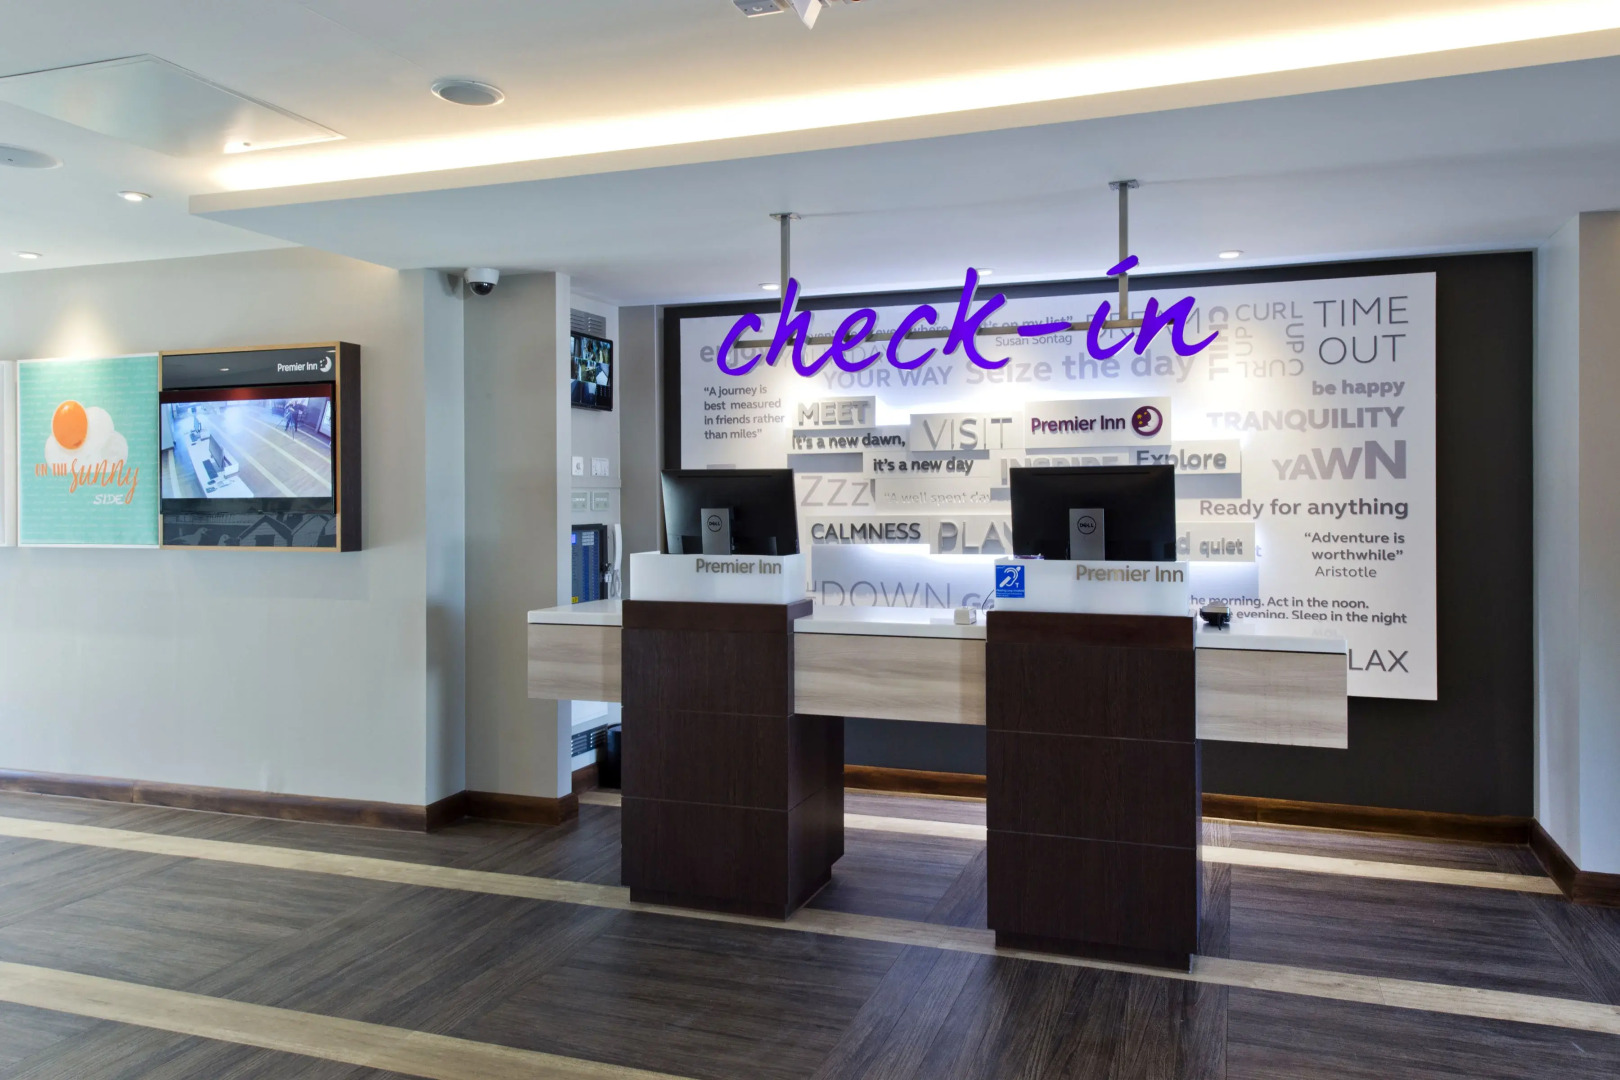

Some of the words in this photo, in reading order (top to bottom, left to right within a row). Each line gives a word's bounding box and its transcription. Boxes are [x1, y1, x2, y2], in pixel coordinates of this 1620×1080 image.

[717, 255, 1219, 377] check-in
[1235, 301, 1303, 322] CURL
[1313, 295, 1409, 328] TIME
[995, 336, 1029, 347] Susan
[1032, 334, 1073, 346] Sontag
[1208, 305, 1229, 381] CHILL
[1235, 326, 1253, 357] UP
[1285, 322, 1305, 354] UP
[1318, 333, 1407, 365] OUT
[277, 362, 306, 373] Premier
[306, 361, 318, 371] Inn
[965, 358, 1053, 385] Seize
[1062, 351, 1121, 381] the
[1130, 347, 1197, 384] day
[1236, 358, 1305, 378] CURL
[822, 367, 891, 391] YOUR
[898, 364, 953, 387] WAY
[704, 385, 717, 396] “A
[717, 386, 758, 398] journey
[759, 384, 768, 394] is
[1312, 380, 1337, 396] be
[1341, 379, 1406, 398] happy
[704, 400, 726, 411] best
[730, 399, 782, 410] measured
[797, 400, 871, 427] MEET
[704, 415, 714, 425] in
[715, 414, 751, 425] friends
[752, 413, 785, 424] rather
[1031, 415, 1096, 435] Premier
[1100, 414, 1126, 431] Inn
[1206, 405, 1405, 432] TRANQUILITY
[704, 429, 728, 440] than
[730, 428, 763, 439] miles”
[816, 438, 826, 450] a
[829, 435, 859, 448] new
[861, 432, 906, 448] dawn,
[922, 416, 1013, 451] VISIT
[873, 458, 896, 473] it’s
[898, 461, 908, 472] a
[911, 459, 943, 472] new
[946, 456, 974, 476] day
[1136, 448, 1227, 471] Explore
[1271, 439, 1407, 481] YAWN
[93, 493, 124, 505] SIDE
[901, 491, 928, 504] well
[930, 491, 967, 507] spent
[1199, 498, 1264, 519] Ready
[1270, 497, 1301, 516] for
[1307, 497, 1409, 520] anything
[811, 522, 921, 541] CALMNESS
[1304, 531, 1390, 544] “Adventure
[1393, 532, 1405, 544] is
[1199, 537, 1243, 559] quiet
[1311, 548, 1404, 561] worthwhile”
[695, 558, 755, 575] Premier
[758, 558, 782, 575] Inn
[1076, 563, 1150, 582] Premier
[1155, 564, 1184, 583] Inn
[1314, 565, 1377, 579] Aristotle
[821, 580, 951, 609] DOWN
[1190, 594, 1206, 605] he
[1209, 595, 1265, 609] morning.
[1267, 596, 1290, 607] Act
[1291, 597, 1304, 608] in
[1306, 597, 1329, 609] the
[1331, 600, 1370, 610] noon.
[1291, 610, 1328, 621] Sleep
[1330, 610, 1343, 622] in
[1345, 611, 1369, 623] the
[1371, 612, 1408, 626] night
